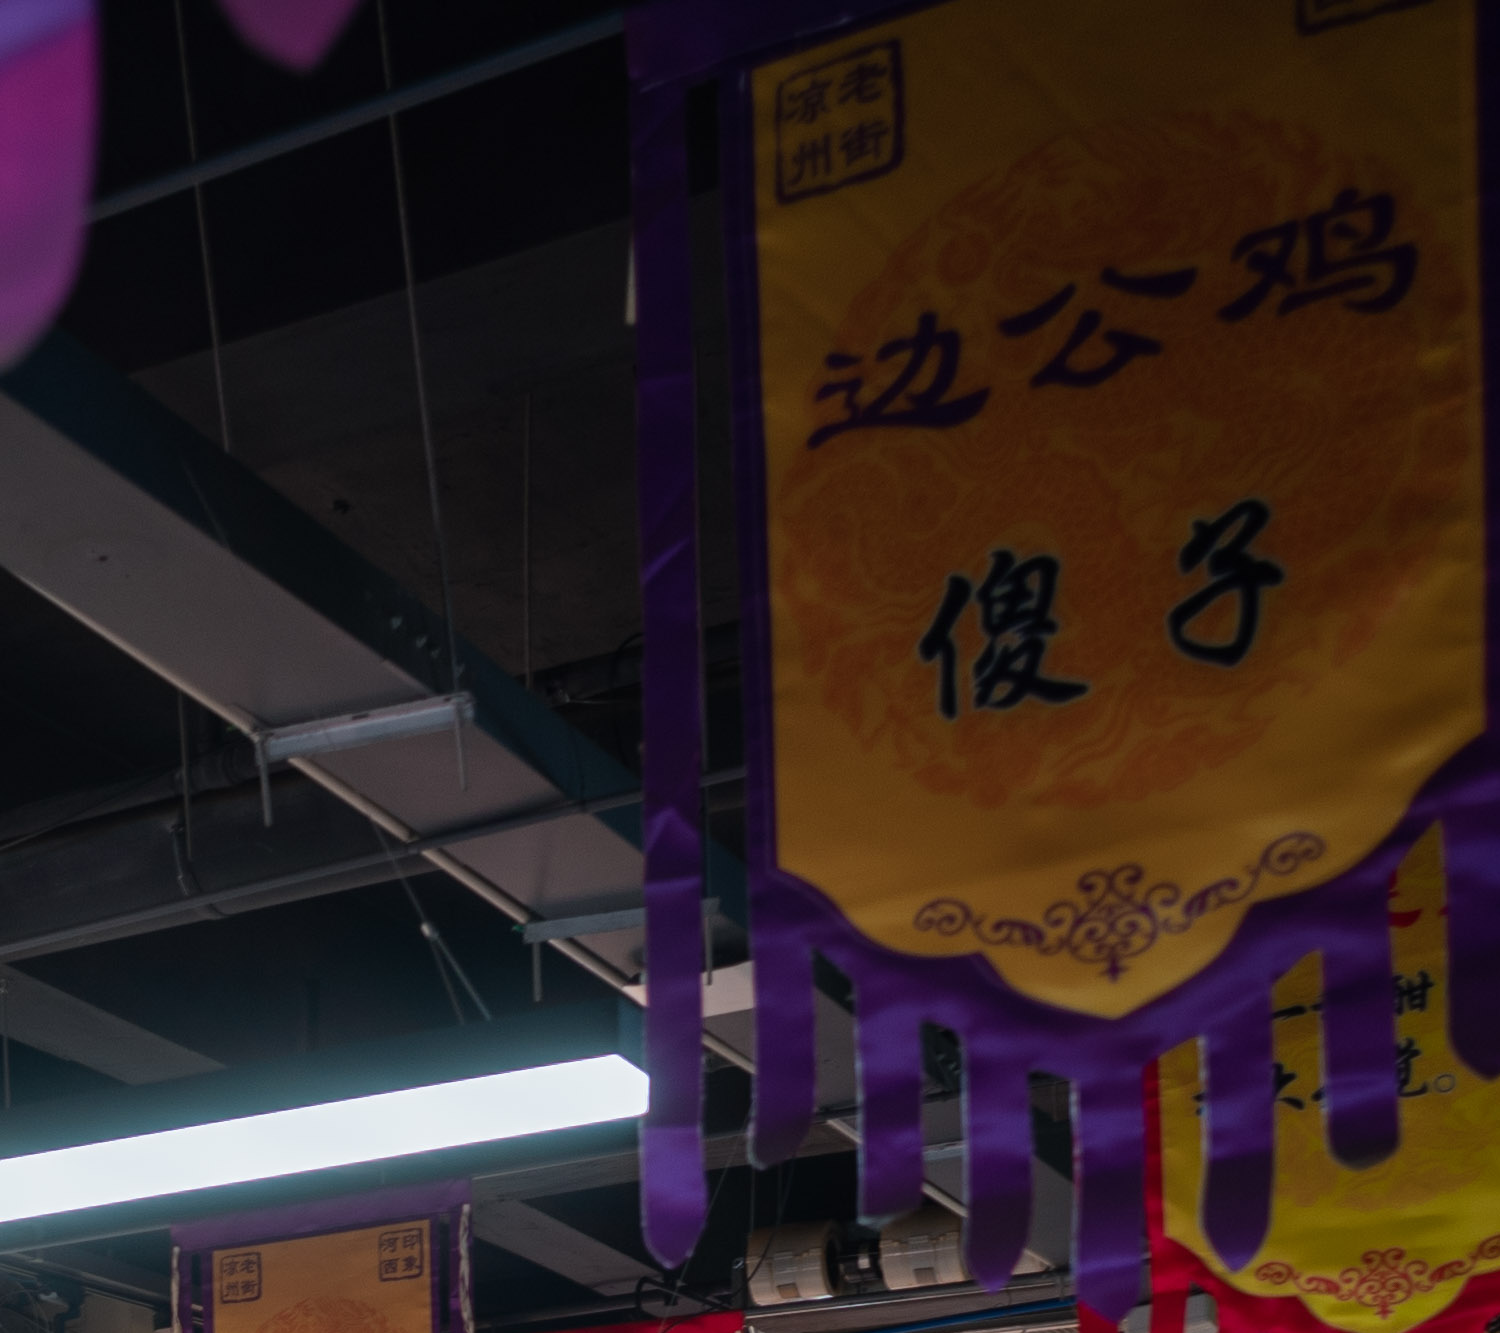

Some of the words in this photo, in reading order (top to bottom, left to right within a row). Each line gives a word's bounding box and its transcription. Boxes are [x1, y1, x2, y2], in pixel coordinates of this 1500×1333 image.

[806, 186, 1419, 450] 边公鸡
[916, 498, 1286, 722] 傻子
